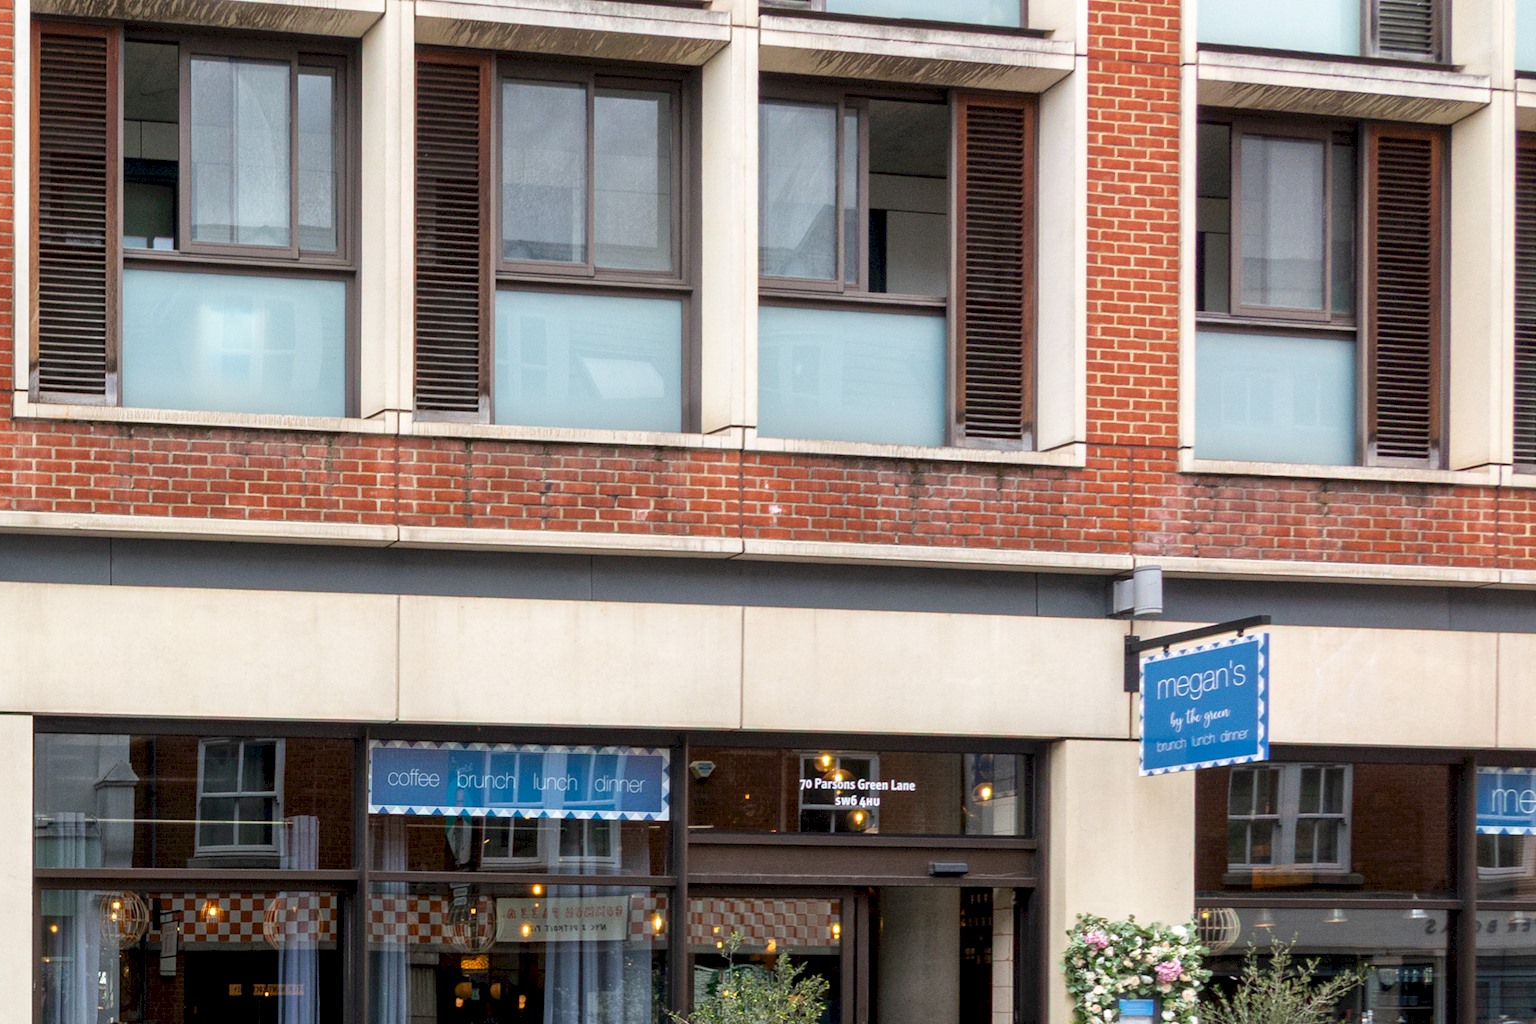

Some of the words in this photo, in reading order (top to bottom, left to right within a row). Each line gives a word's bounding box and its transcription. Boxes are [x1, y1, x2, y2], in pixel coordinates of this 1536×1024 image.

[1157, 660, 1246, 700] megan's
[1170, 711, 1184, 733] by
[1186, 707, 1201, 724] the
[1203, 708, 1231, 728] green
[1156, 737, 1187, 752] brunch
[1191, 732, 1215, 747] lunch
[1220, 728, 1249, 743] dinner
[387, 768, 441, 788] coffee
[456, 770, 516, 790] brunch
[533, 772, 578, 792] lunch
[594, 775, 646, 793] dinner
[799, 779, 813, 790] 70
[815, 778, 856, 790] Parsons
[857, 779, 888, 791] Green
[891, 779, 916, 791] Lane
[835, 795, 857, 806] SW6
[859, 796, 880, 808] 4HU
